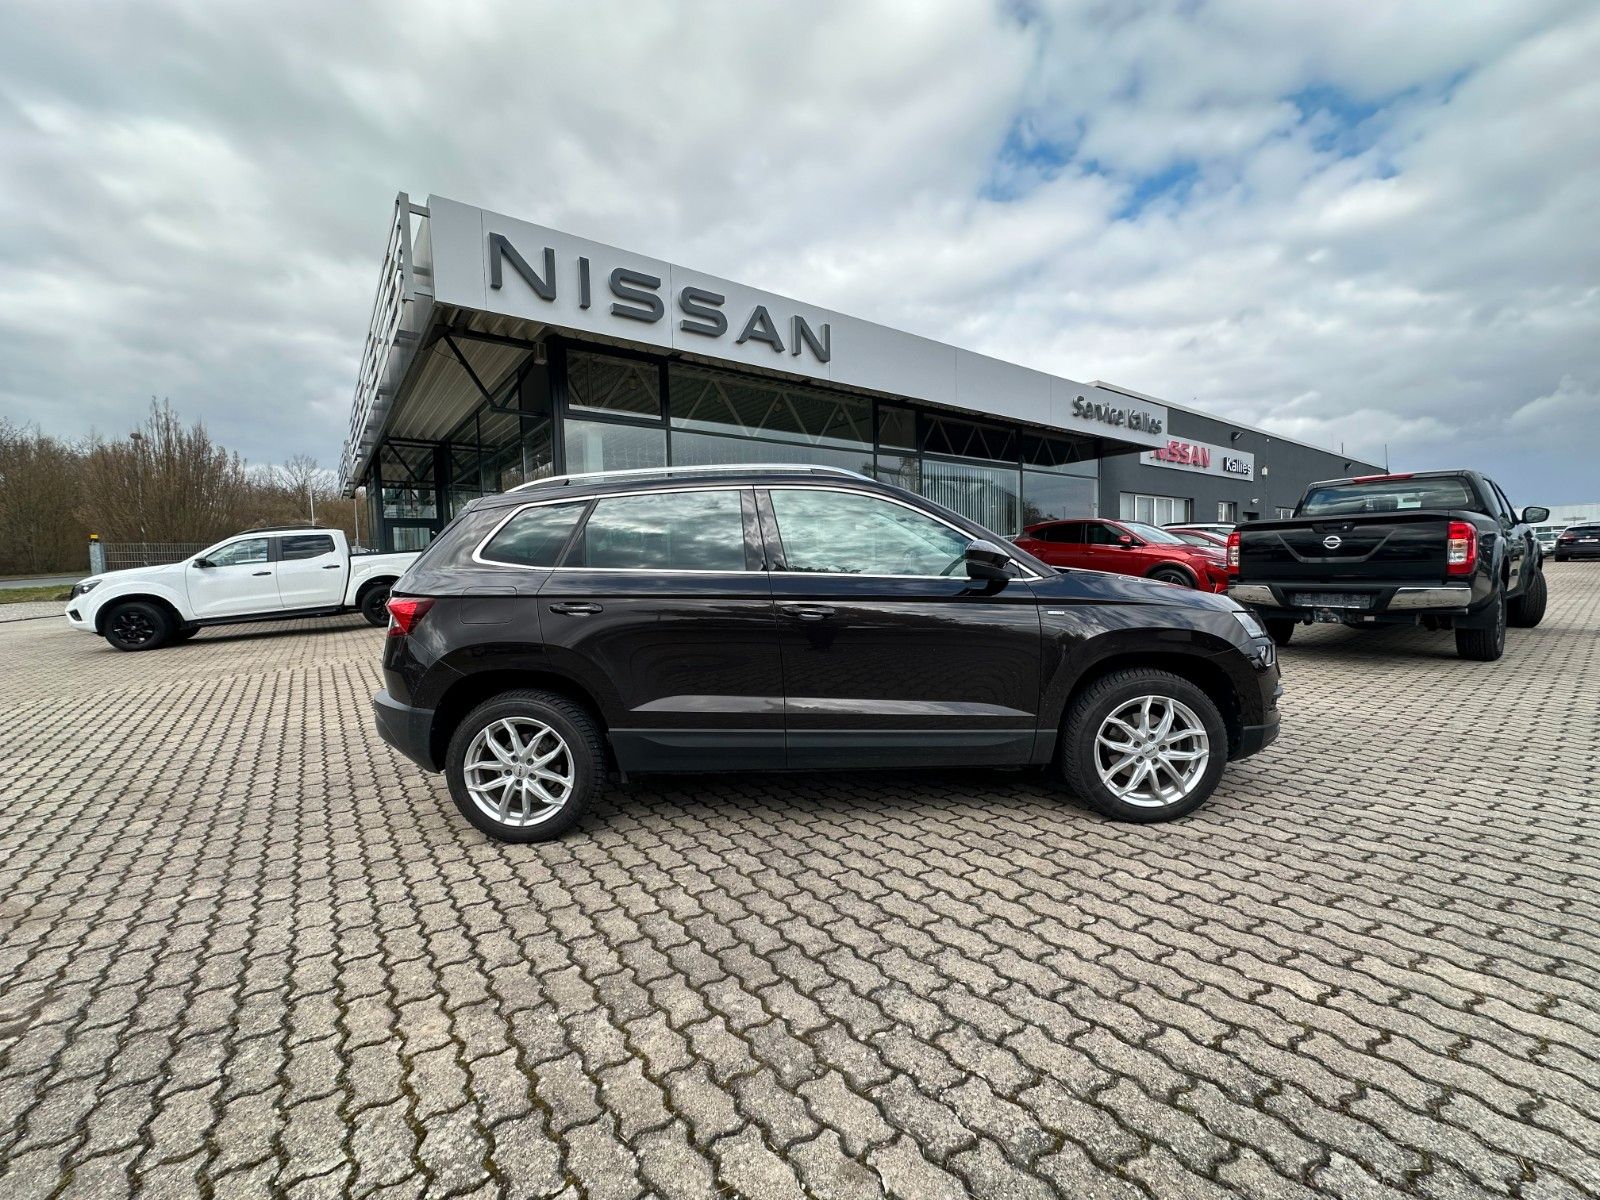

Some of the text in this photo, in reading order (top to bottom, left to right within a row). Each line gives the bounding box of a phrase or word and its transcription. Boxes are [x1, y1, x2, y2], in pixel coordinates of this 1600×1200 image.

[488, 231, 831, 363] NISSAN
[1072, 395, 1163, 435] Service Kallies
[1223, 456, 1252, 475] Kallies
